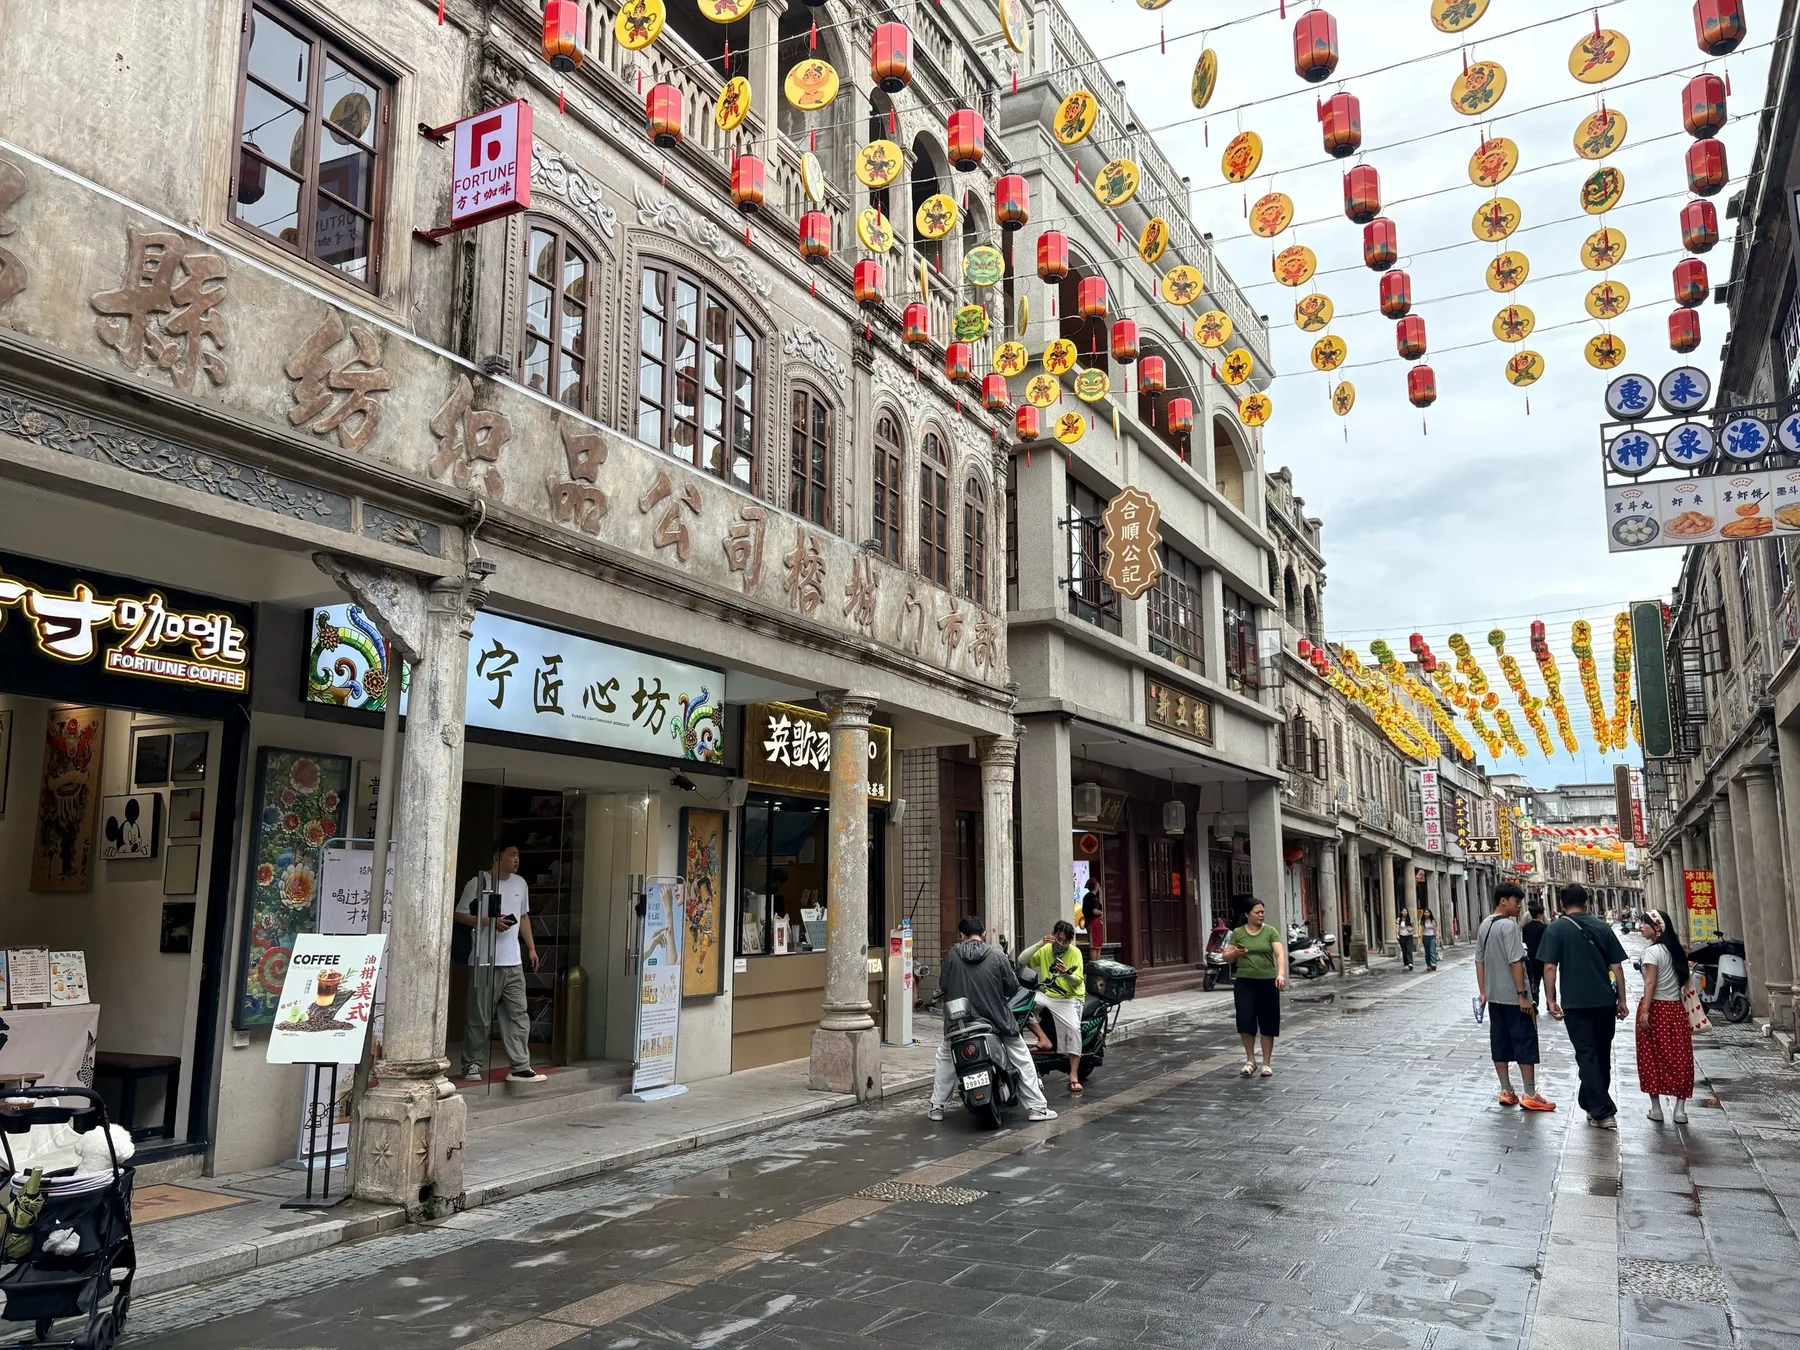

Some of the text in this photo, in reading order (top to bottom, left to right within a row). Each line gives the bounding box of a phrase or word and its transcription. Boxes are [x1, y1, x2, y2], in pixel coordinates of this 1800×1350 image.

[454, 161, 516, 193] FORTUNE
[456, 181, 512, 210] 方寸咖啡
[1617, 372, 1703, 411] 惠来
[1120, 501, 1142, 583] 合順公記
[110, 652, 244, 687] FORTUNE COFFEE
[293, 955, 341, 966] COFFEE
[867, 958, 883, 974] TEA
[345, 954, 377, 1022] 油柑美式
